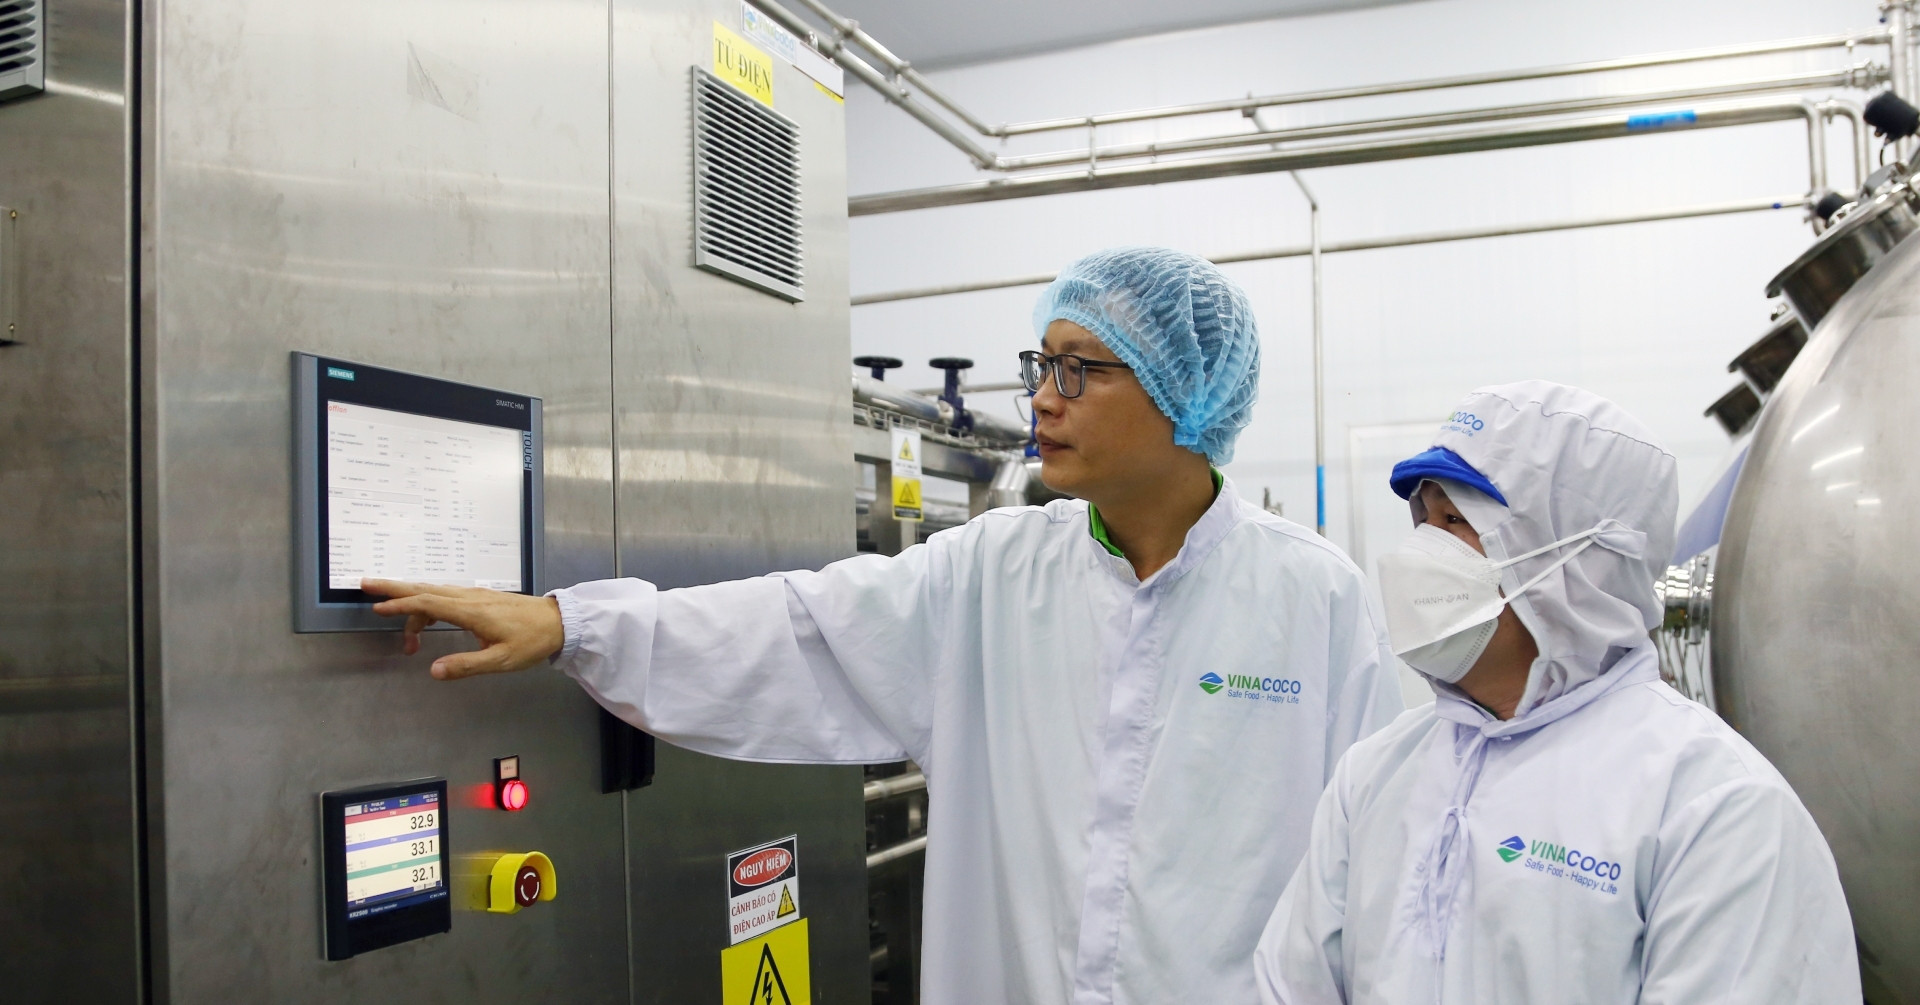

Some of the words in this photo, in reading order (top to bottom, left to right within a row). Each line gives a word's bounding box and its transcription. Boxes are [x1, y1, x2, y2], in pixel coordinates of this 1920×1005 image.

[714, 37, 734, 71] TỦ
[739, 52, 771, 94] ĐIỆN
[328, 369, 354, 380] SIEMENS
[495, 399, 515, 410] SIMATIC
[514, 402, 525, 411] HMI
[524, 432, 532, 470] TOUCH
[1227, 673, 1301, 695] VINACOCO
[1227, 689, 1243, 699] Safe
[1244, 690, 1260, 700] Food
[1266, 693, 1285, 705] Happy
[1286, 695, 1299, 705] Life
[410, 813, 434, 830] 32.9
[411, 840, 435, 857] 33.1
[1530, 839, 1622, 881] VINACOCO
[412, 866, 434, 883] 32.1
[739, 860, 764, 881] NGUY
[766, 851, 787, 872] HIỂM
[1524, 857, 1545, 872] Safe
[1546, 863, 1564, 878] Food
[1570, 870, 1600, 891] Happy
[1600, 881, 1618, 895] Life
[731, 901, 751, 917] CẢNH
[752, 894, 766, 910] BÁO
[767, 889, 776, 904] CÓ
[733, 918, 751, 935] ĐIỆN
[751, 913, 766, 928] CAO
[766, 909, 776, 923] ÁP
